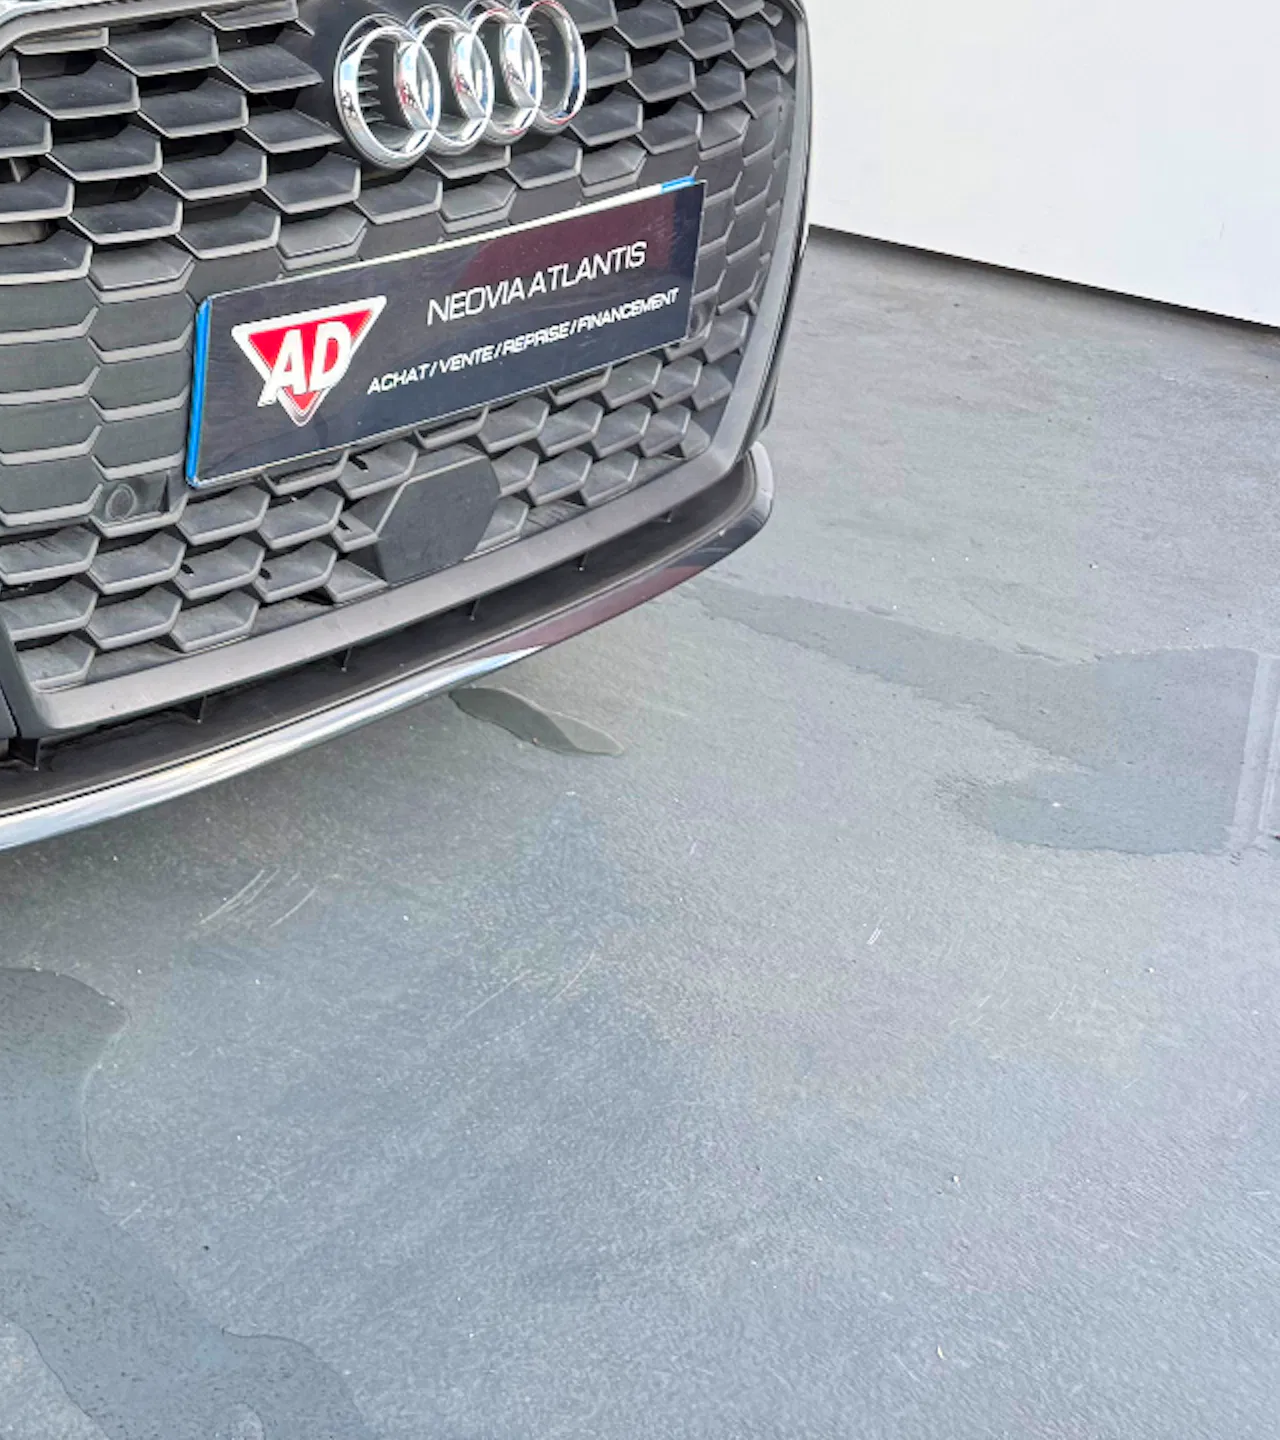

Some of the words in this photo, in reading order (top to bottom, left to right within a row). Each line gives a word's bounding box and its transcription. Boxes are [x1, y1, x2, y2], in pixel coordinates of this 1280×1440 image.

[427, 281, 525, 325] NEOVIA
[528, 241, 648, 296] ATLANTIS
[257, 321, 352, 407] AD
[366, 361, 430, 395] ACHAT
[439, 345, 493, 373] VENTE
[502, 323, 570, 356] REPRISE
[577, 288, 679, 333] FINANCEMENT
